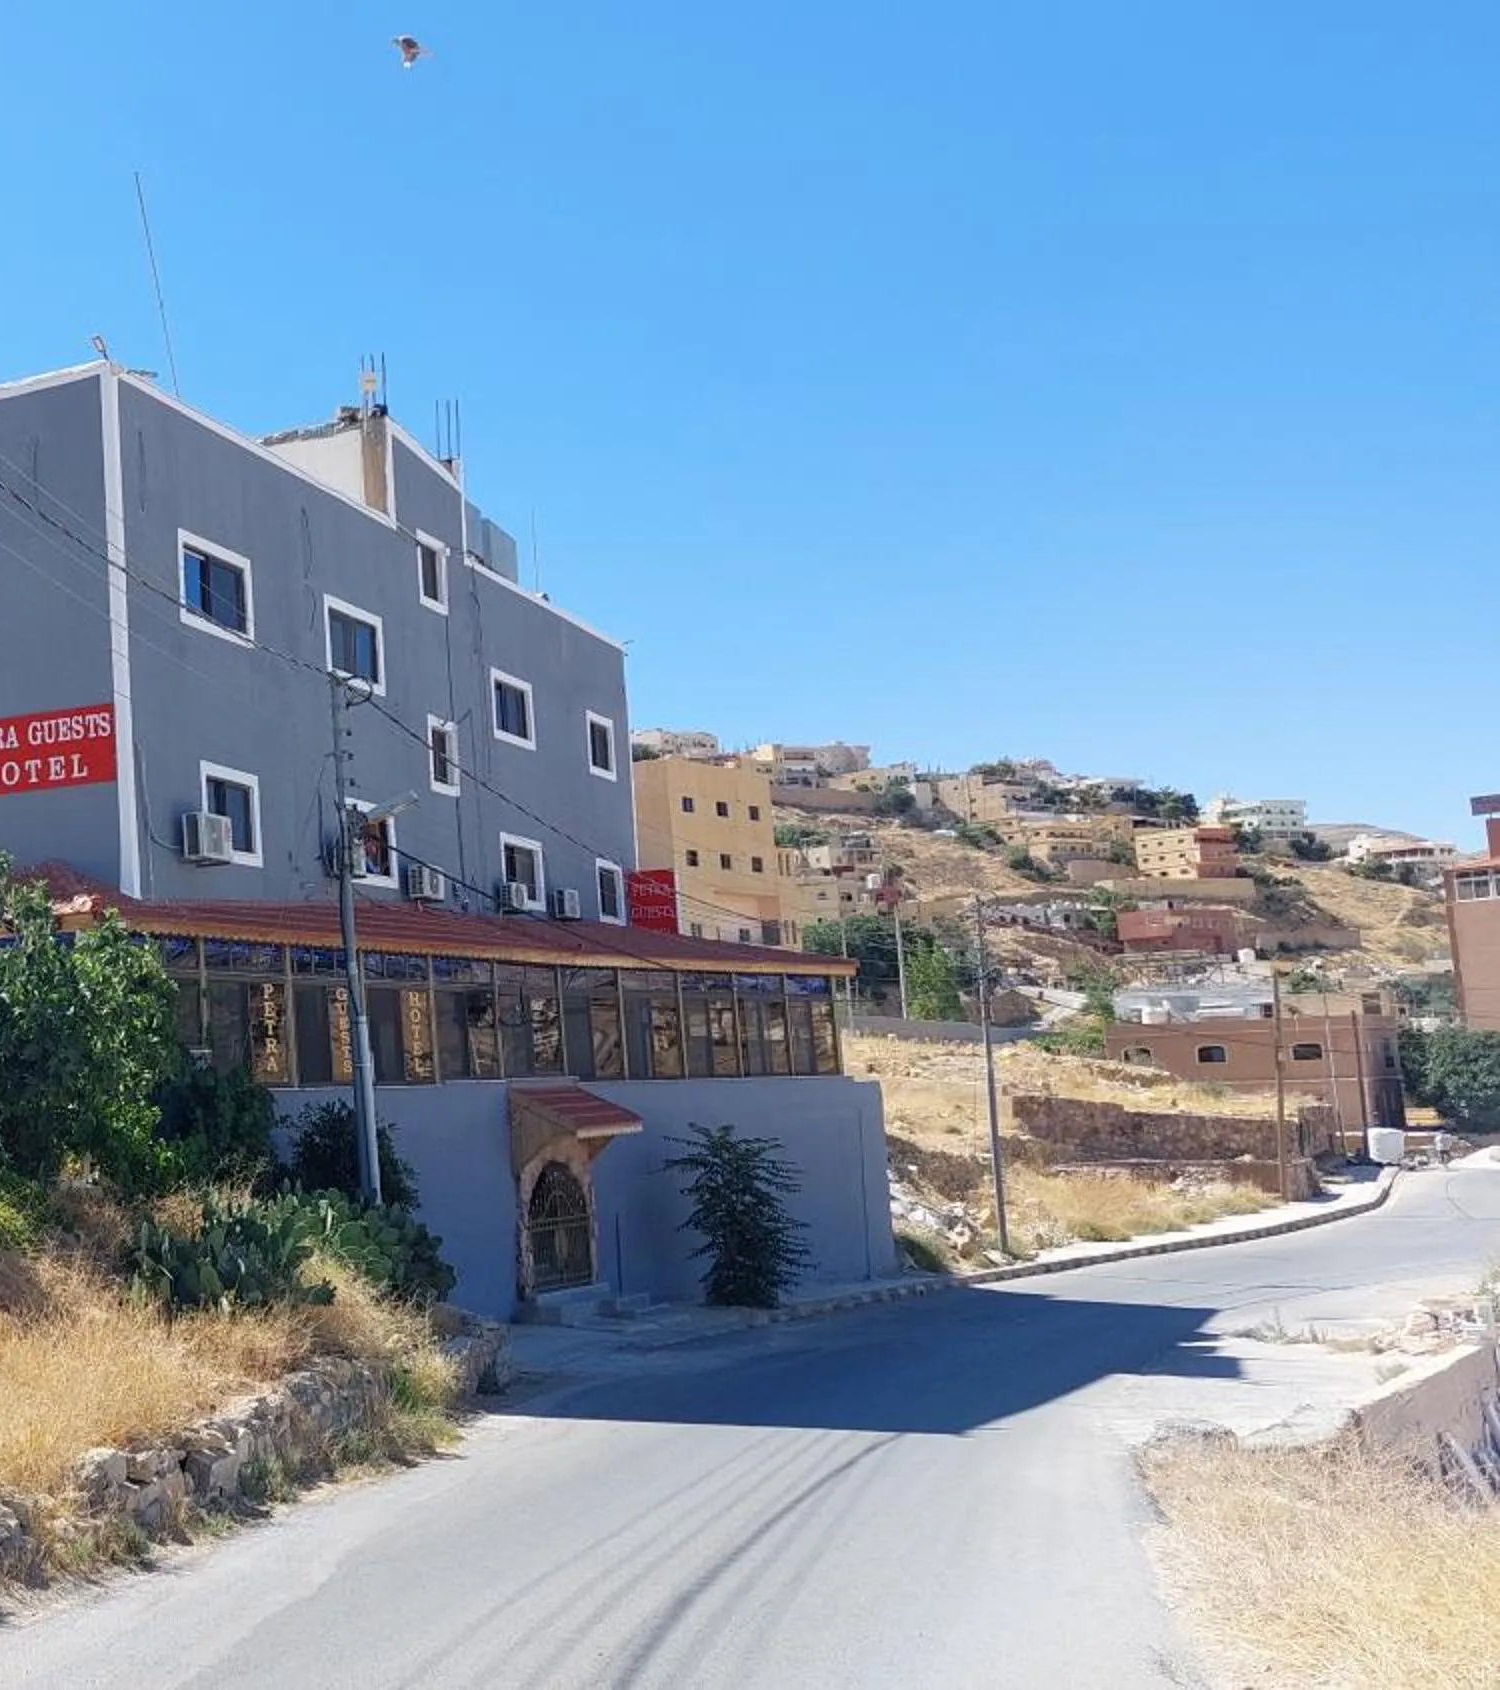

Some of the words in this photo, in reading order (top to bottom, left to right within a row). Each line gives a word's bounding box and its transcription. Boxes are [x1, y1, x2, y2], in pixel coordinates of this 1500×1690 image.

[28, 712, 111, 745] GUESTS
[262, 983, 278, 1073] PETRA
[334, 987, 353, 1073] GUESTS
[408, 991, 425, 1073] HOTEL
